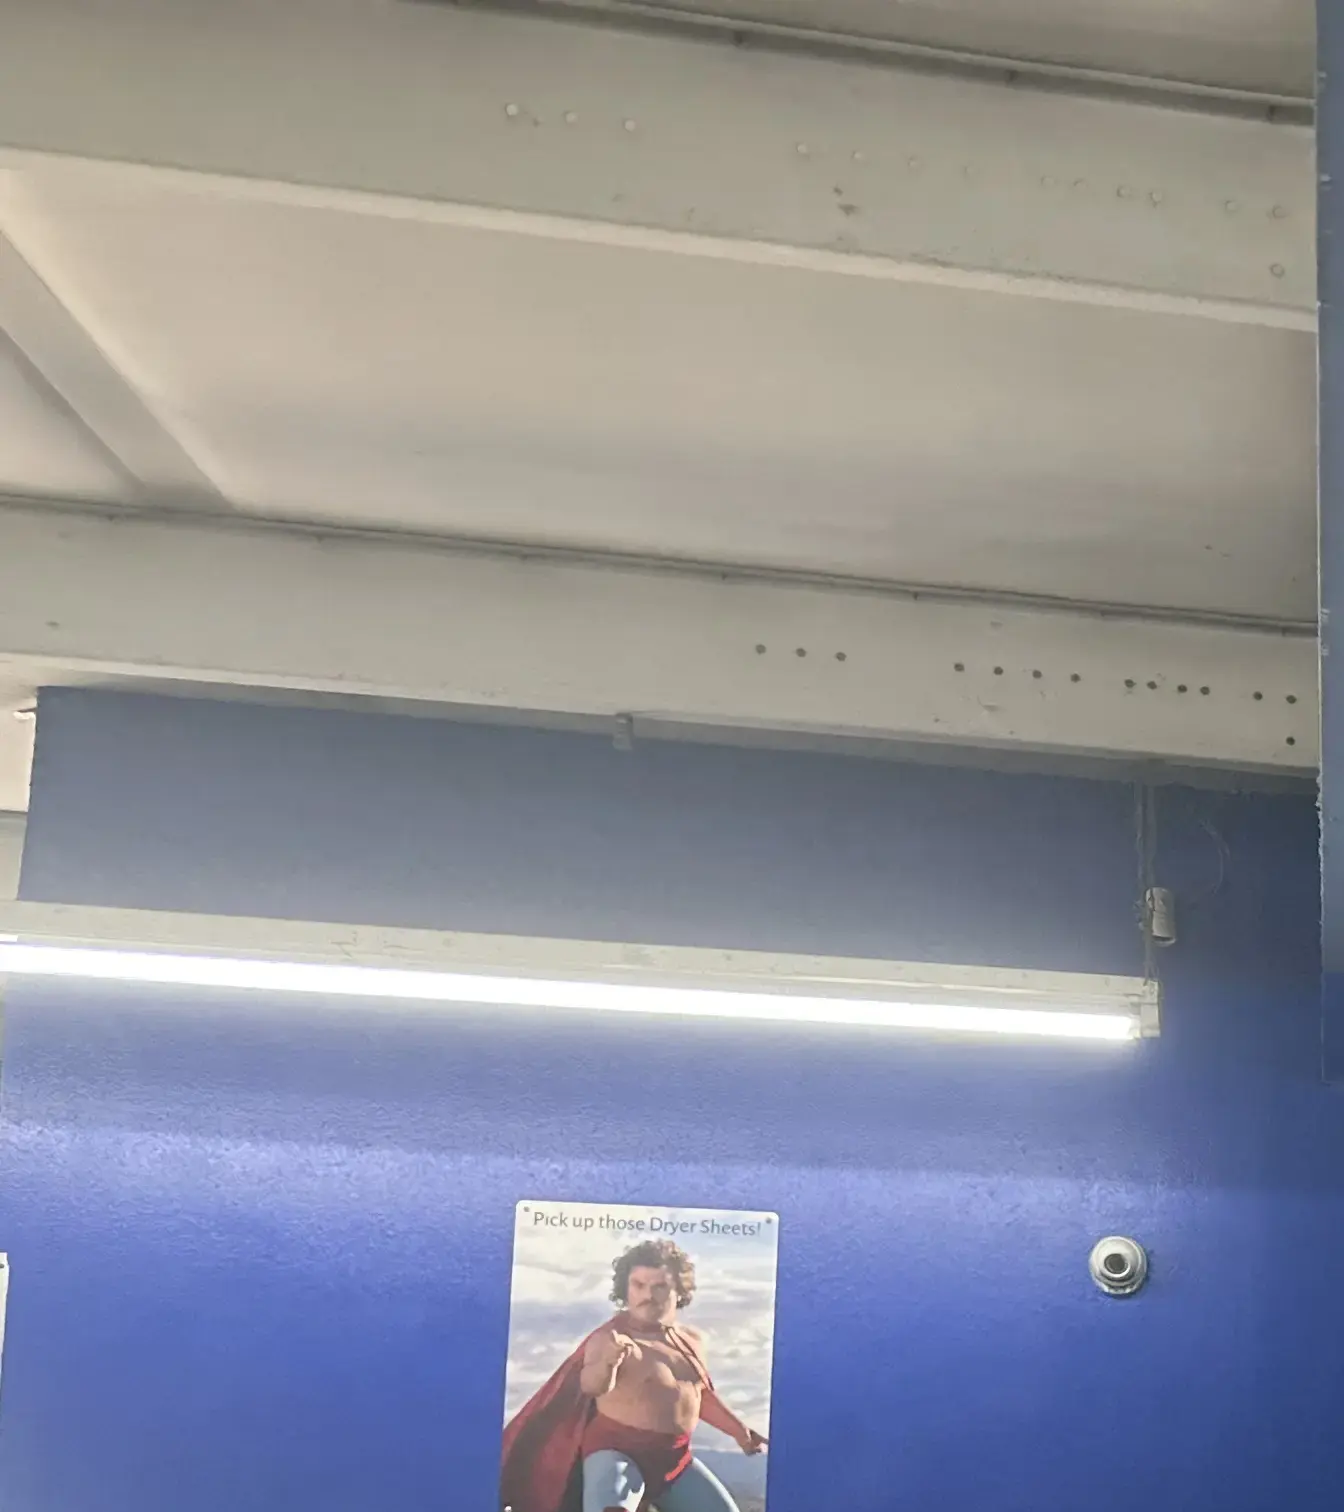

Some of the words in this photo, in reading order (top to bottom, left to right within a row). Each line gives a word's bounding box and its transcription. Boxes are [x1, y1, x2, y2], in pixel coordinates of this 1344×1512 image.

[533, 1211, 568, 1227] Pick
[572, 1217, 595, 1231] up
[599, 1213, 645, 1231] those
[650, 1217, 697, 1236] Dryer
[700, 1218, 761, 1236] Sheets!
